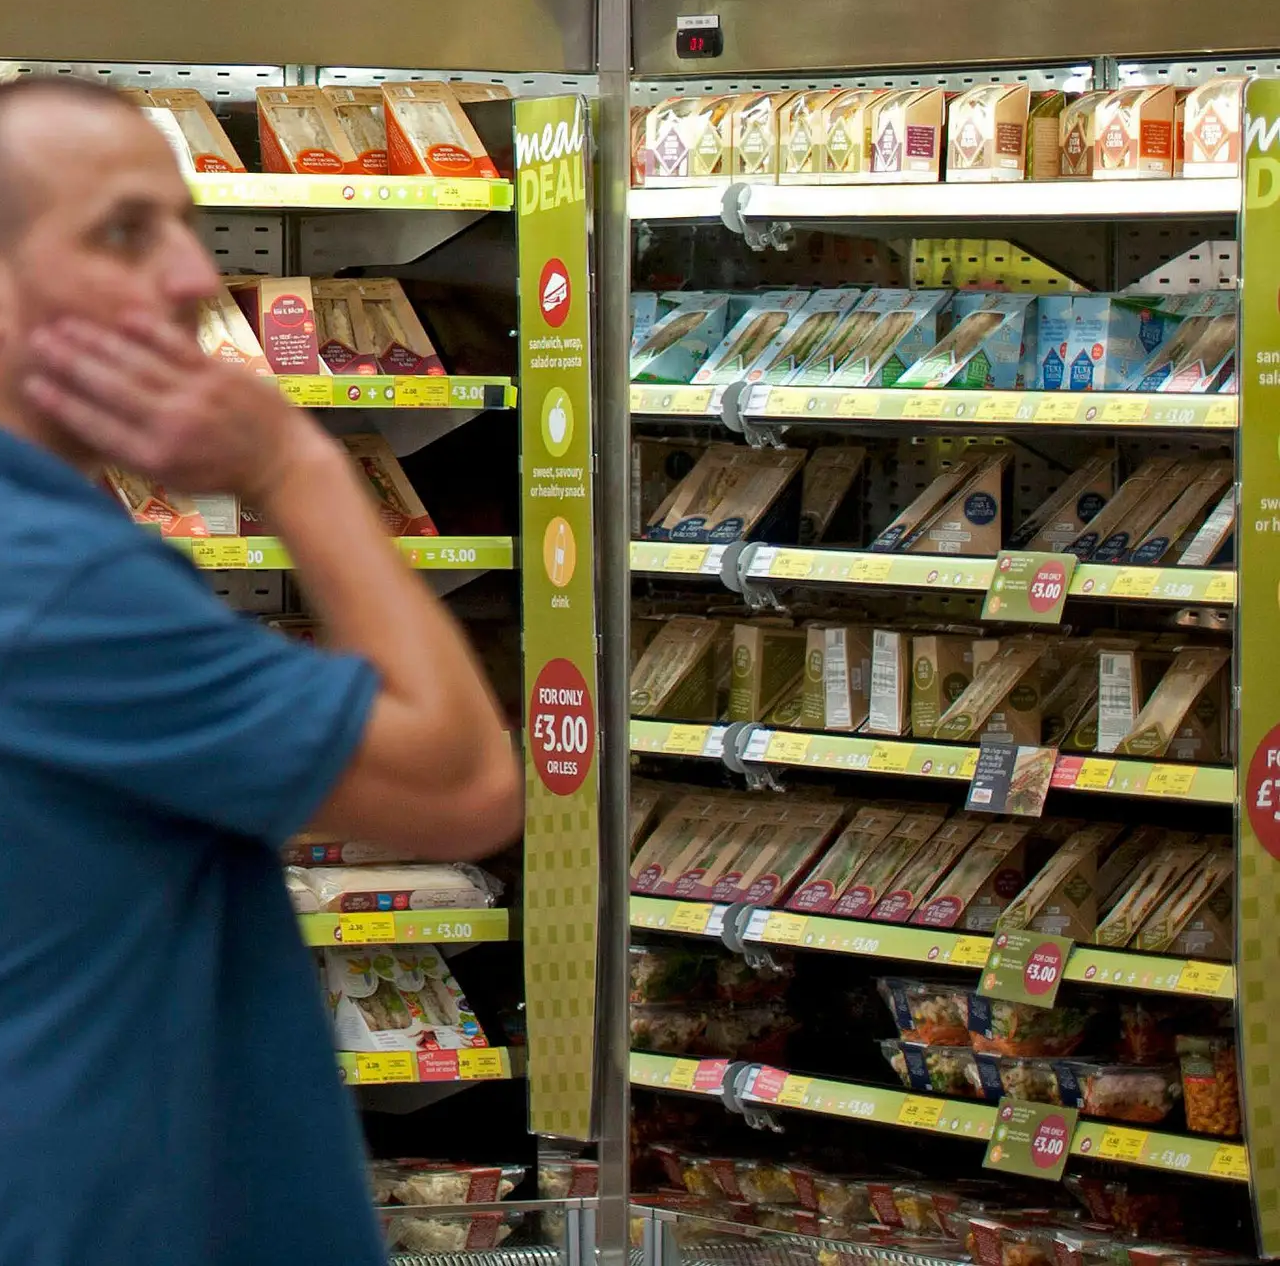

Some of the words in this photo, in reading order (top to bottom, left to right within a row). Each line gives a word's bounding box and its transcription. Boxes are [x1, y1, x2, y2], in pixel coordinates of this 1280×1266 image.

[516, 96, 584, 169] meal
[520, 155, 586, 216] DEAL
[529, 337, 563, 351] sandwich,
[564, 339, 583, 353] wrap,
[530, 356, 549, 369] salad
[549, 358, 557, 368] or
[563, 357, 582, 370] pasta
[1259, 371, 1280, 385] sal
[533, 467, 554, 479] sweet,
[555, 467, 583, 481] savoury
[538, 484, 564, 500] healthy
[565, 486, 585, 498] snack
[1255, 518, 1271, 531] or
[440, 548, 477, 562] £3.00
[1031, 583, 1061, 599] £3.00
[551, 594, 571, 608] drink
[539, 688, 558, 705] FOR
[558, 690, 584, 706] ONLY
[534, 714, 588, 754] £3.00
[546, 761, 559, 774] OR
[559, 762, 578, 776] LESS
[438, 923, 473, 938] £3.00
[1027, 964, 1056, 983] £3.00
[1034, 1136, 1064, 1154] £3.00
